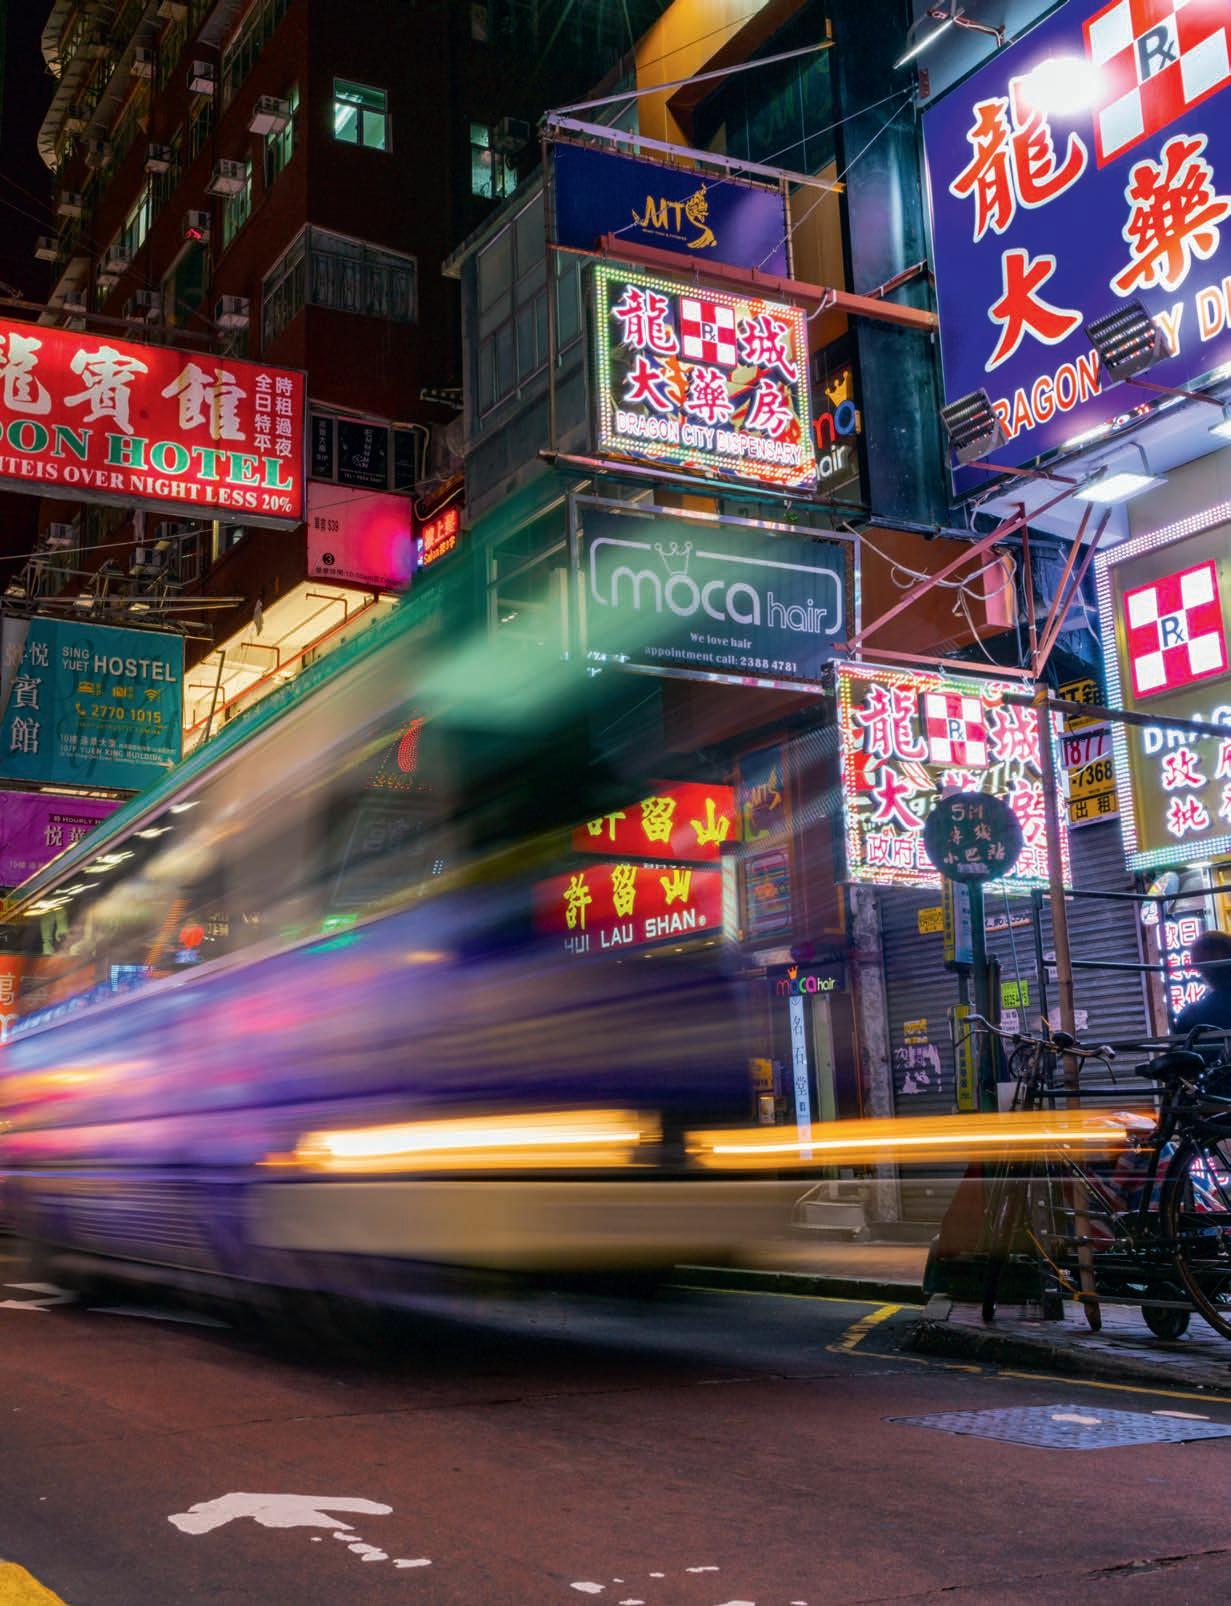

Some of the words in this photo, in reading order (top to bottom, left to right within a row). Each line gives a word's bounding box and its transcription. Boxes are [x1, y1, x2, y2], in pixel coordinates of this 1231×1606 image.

[612, 284, 680, 356] 龍
[624, 355, 796, 437] 大藥房
[275, 376, 293, 458] 時租過夜
[615, 410, 680, 442] DRAGON
[681, 422, 715, 449] CITY
[716, 428, 803, 465] DISPENSARY
[104, 432, 293, 491] HOTEL
[63, 465, 125, 489] OVER
[130, 473, 201, 500] NIGHT
[205, 485, 257, 508] LESS
[262, 494, 292, 513] 20%
[611, 565, 761, 626] moca
[767, 591, 827, 634] hair
[62, 646, 90, 659] SING
[690, 631, 704, 643] We
[707, 634, 728, 646] love
[731, 638, 752, 648] hair
[62, 659, 90, 672] YUET
[94, 655, 177, 682] HOSTEL
[645, 646, 713, 662] appointment
[716, 655, 738, 665] call:
[740, 656, 769, 669] 2388
[771, 660, 797, 672] 4781
[91, 704, 125, 721] 2770
[857, 684, 929, 762] 龍
[1075, 795, 1111, 819] 出租
[63, 817, 92, 825] HOURLY
[601, 923, 633, 948] LAU
[776, 976, 817, 995] moca
[817, 977, 836, 991] hair
